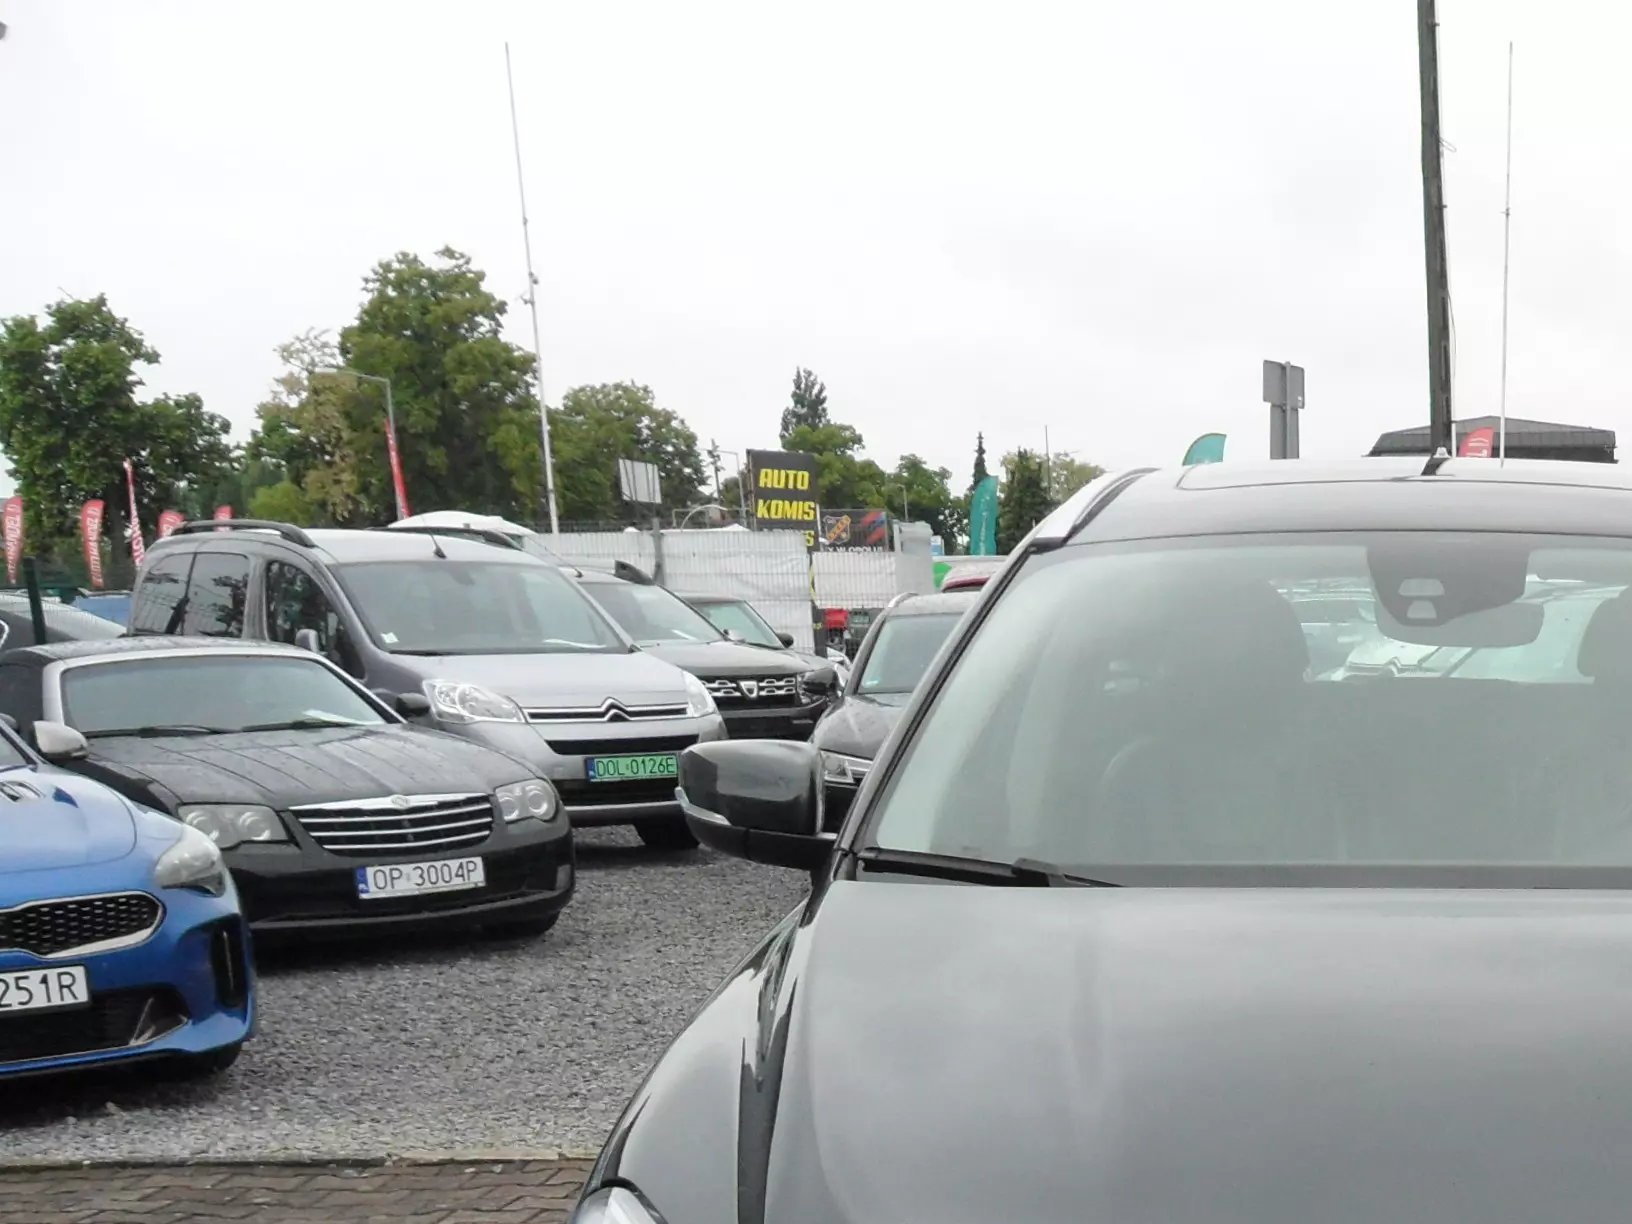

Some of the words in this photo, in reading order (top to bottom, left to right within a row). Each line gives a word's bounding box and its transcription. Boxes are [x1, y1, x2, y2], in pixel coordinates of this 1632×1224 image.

[759, 468, 809, 490] AUTO
[757, 499, 816, 521] KOMIS
[596, 760, 626, 777] DOL
[630, 757, 676, 775] 0126E
[373, 867, 403, 890] OP
[412, 860, 478, 887] 3004P
